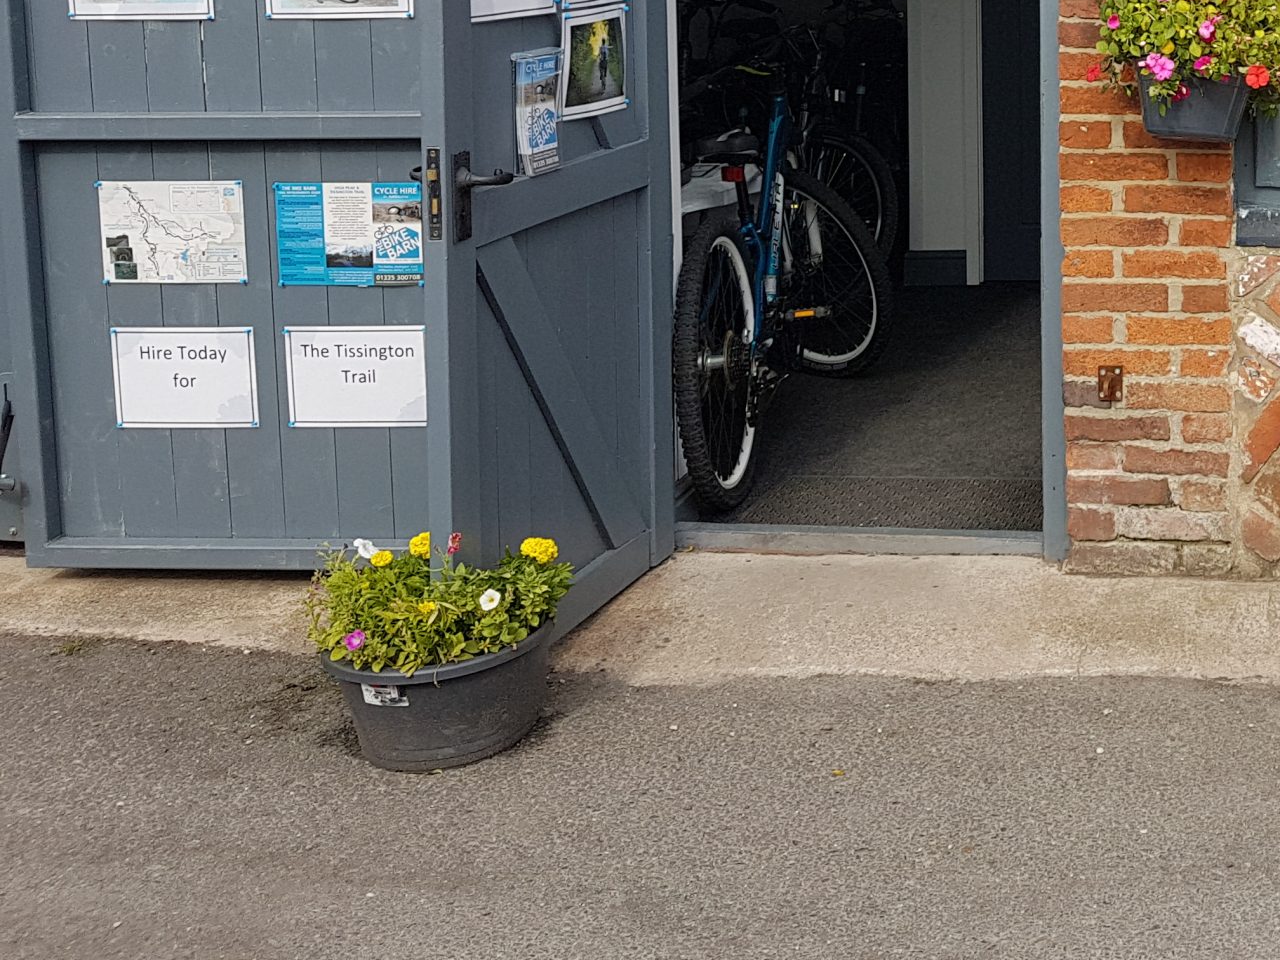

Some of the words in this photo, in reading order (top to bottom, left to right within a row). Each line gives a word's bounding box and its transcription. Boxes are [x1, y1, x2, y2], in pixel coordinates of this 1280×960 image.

[533, 110, 550, 135] BIKE
[537, 120, 557, 146] BARN
[374, 187, 399, 195] CYCLE
[400, 187, 417, 195] HIRE
[382, 227, 411, 248] BIKE
[387, 236, 420, 259] BARN
[139, 345, 173, 360] Hire
[177, 344, 227, 363] Today
[300, 343, 330, 358] The
[333, 343, 415, 360] Tissington
[173, 372, 197, 388] for
[341, 369, 377, 384] Trail
